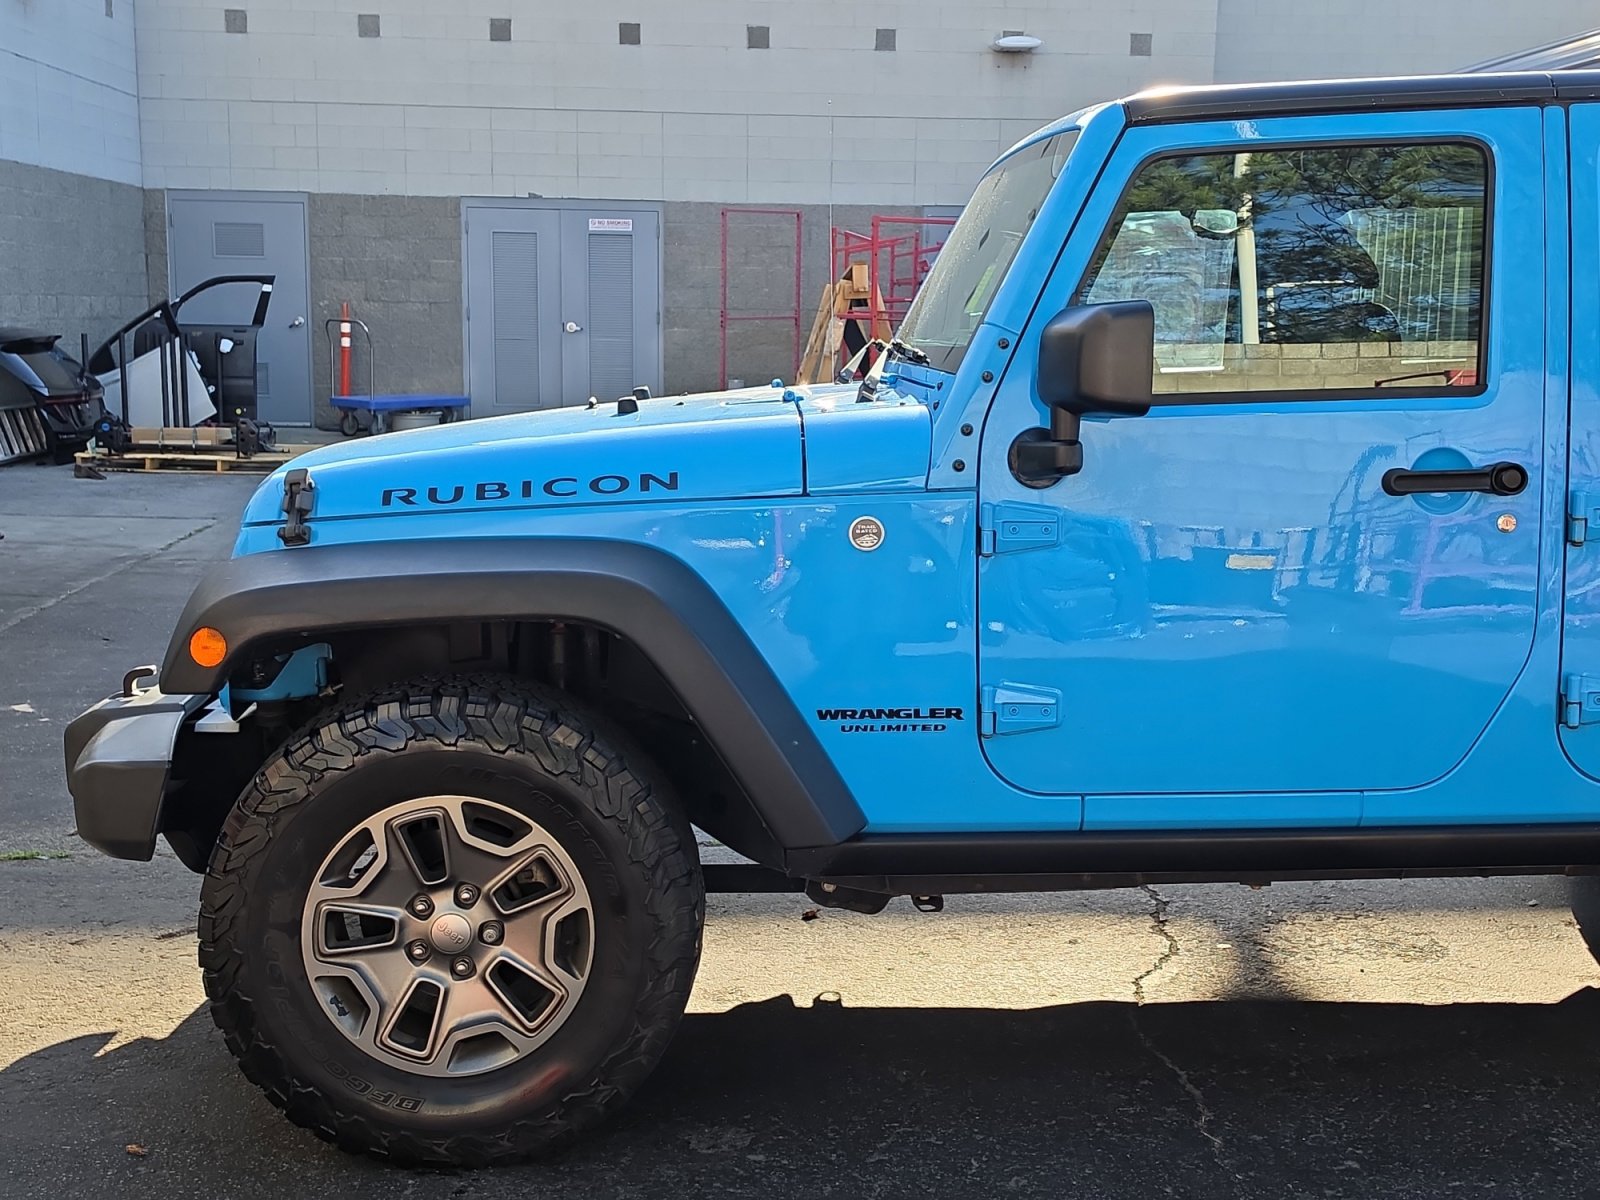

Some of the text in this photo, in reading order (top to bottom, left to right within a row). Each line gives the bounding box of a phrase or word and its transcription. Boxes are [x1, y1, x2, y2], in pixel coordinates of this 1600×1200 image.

[381, 471, 679, 507] RUBICON
[816, 707, 965, 721] WRANGLER
[840, 723, 947, 733] UNLIMITED
[436, 922, 465, 945] Jeep
